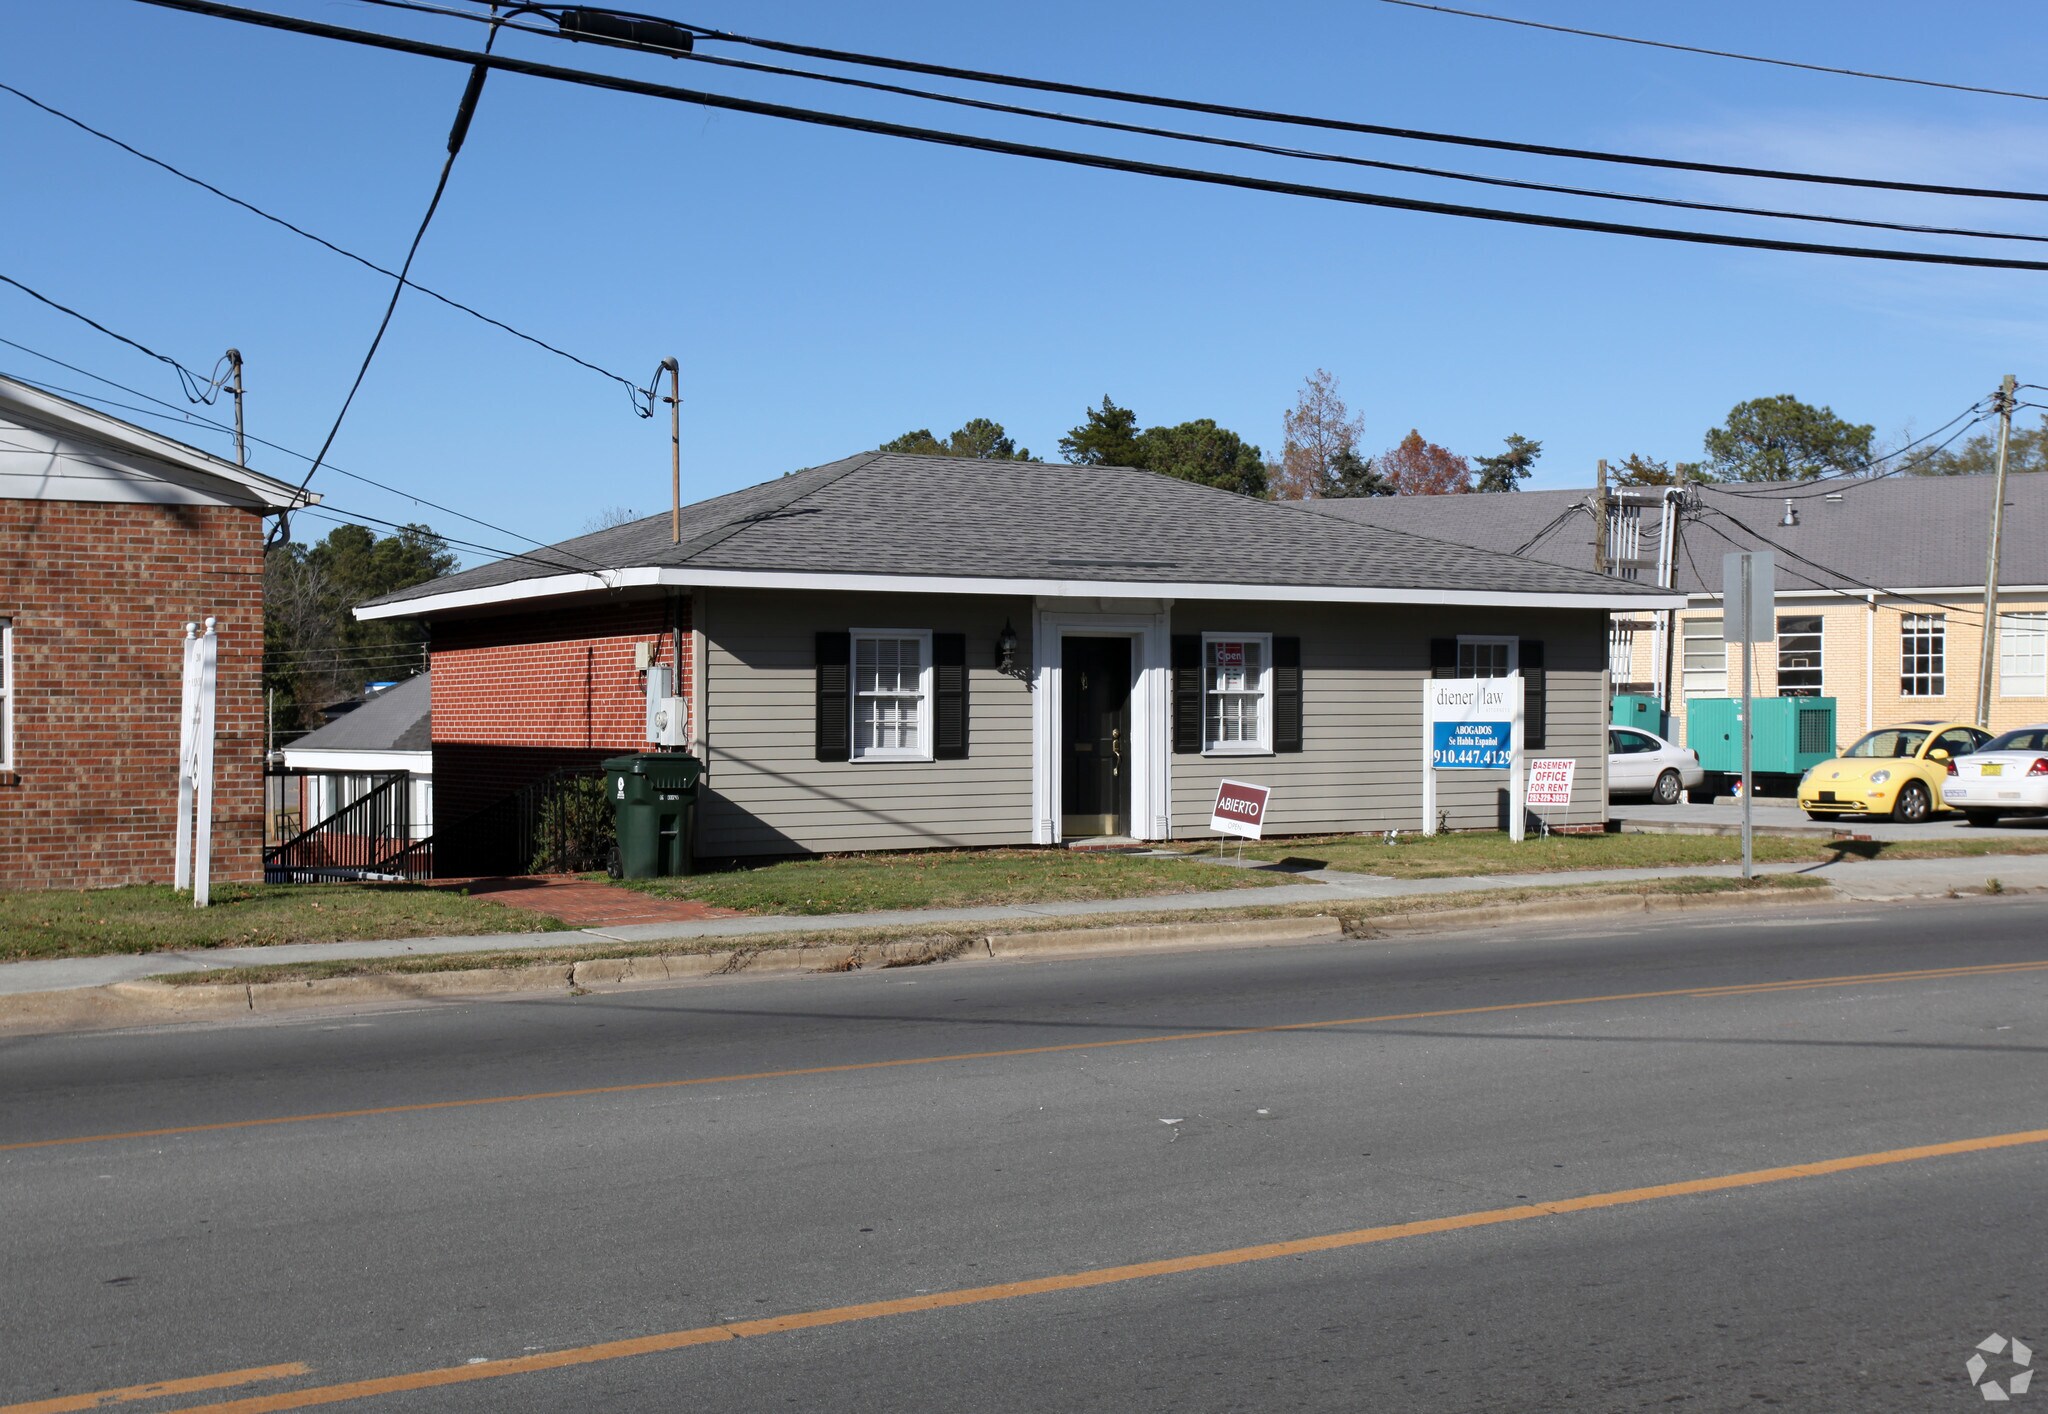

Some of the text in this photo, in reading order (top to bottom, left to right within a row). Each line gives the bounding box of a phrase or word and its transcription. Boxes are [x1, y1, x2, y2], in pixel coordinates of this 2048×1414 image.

[1218, 651, 1241, 661] Open
[1436, 688, 1503, 705] diener law
[1455, 726, 1492, 735] ABOGADOS
[1449, 737, 1498, 748] Se Habla Español
[1434, 749, 1511, 764] 910.447.4129
[1533, 761, 1573, 769] BASEMENT
[1535, 772, 1567, 781] OFFICE
[1548, 784, 1569, 792] RENT
[1218, 797, 1259, 816] ABIERTO
[1227, 822, 1242, 831] OPEN
